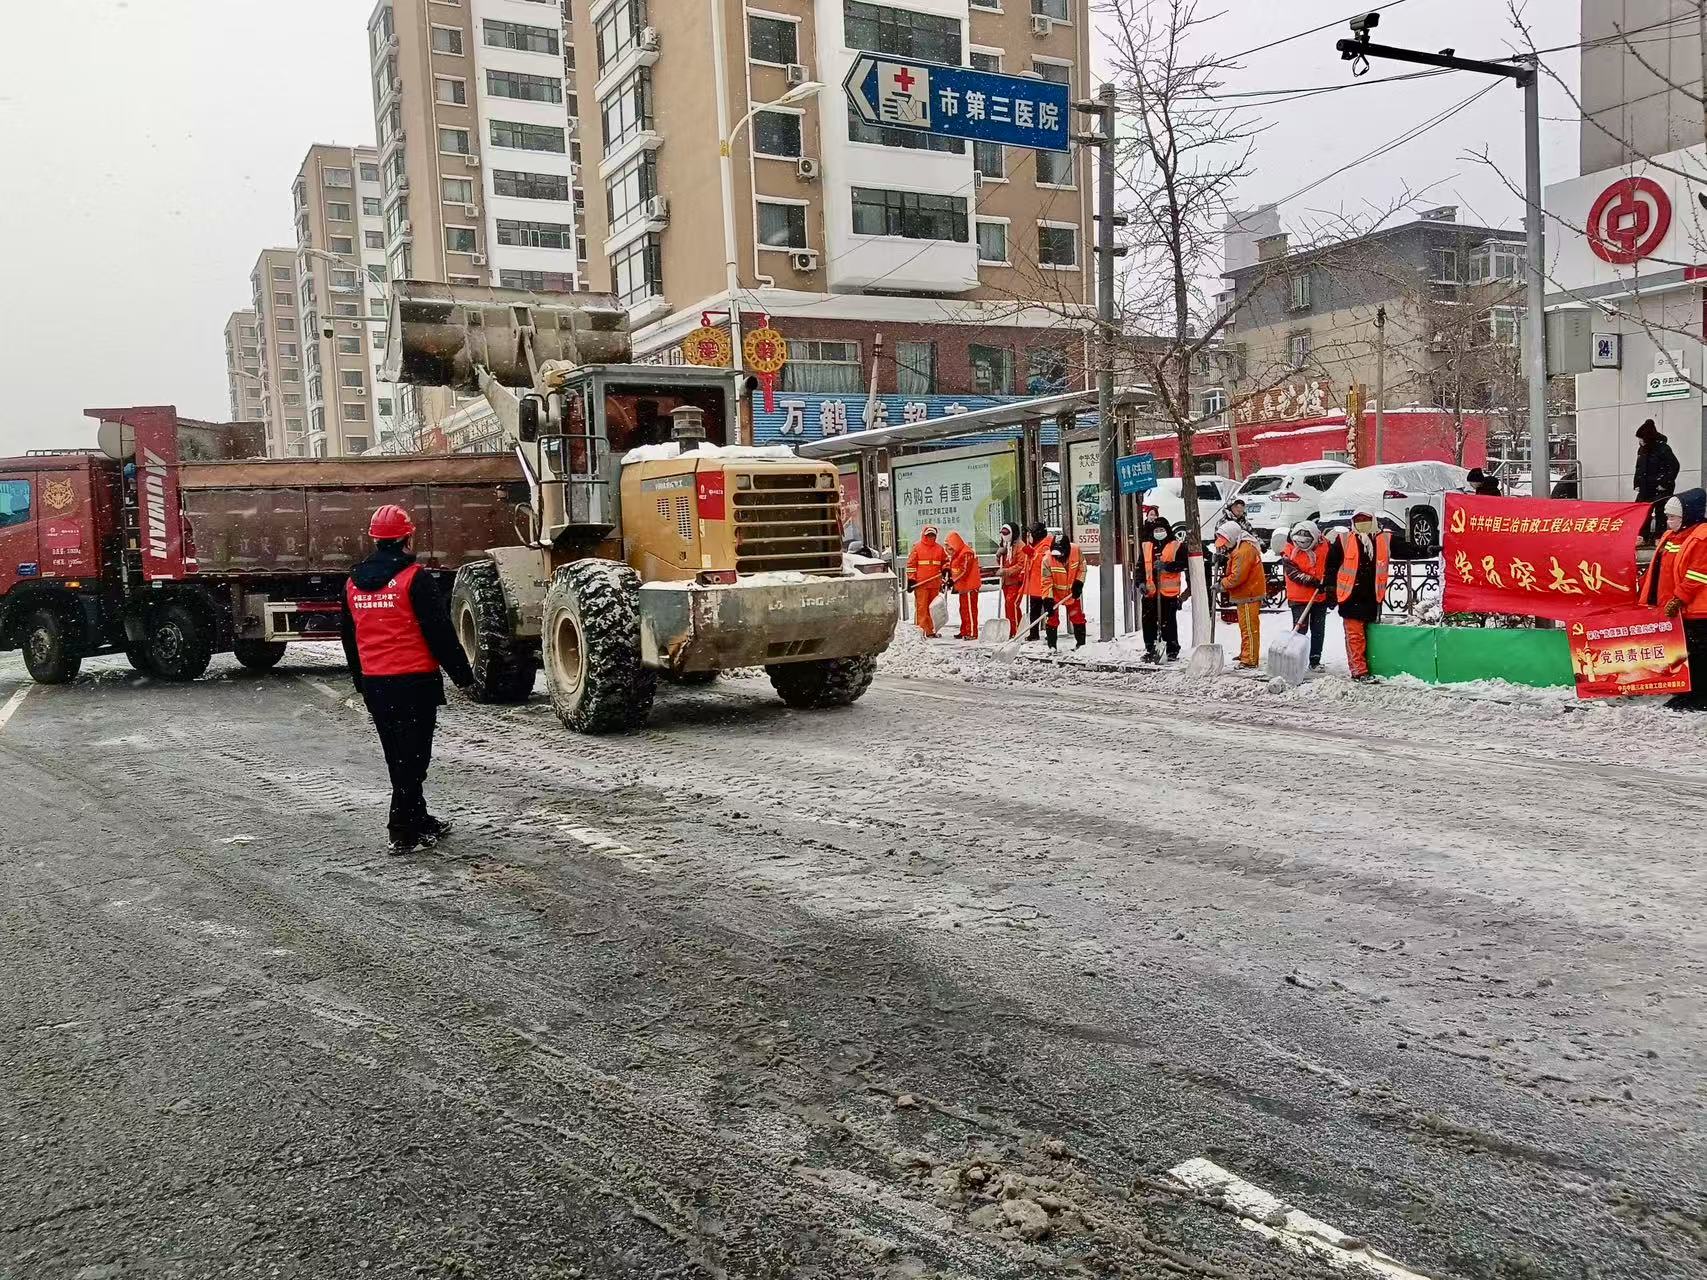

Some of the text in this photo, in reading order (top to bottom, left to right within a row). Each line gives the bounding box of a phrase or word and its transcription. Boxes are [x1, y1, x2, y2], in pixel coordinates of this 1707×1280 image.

[938, 87, 1060, 132] 市第三医院
[903, 486, 933, 506] 内购会
[1469, 515, 1624, 534] 中共中国三冶市政工程公司委员会
[1600, 644, 1665, 665] 党员责任区
